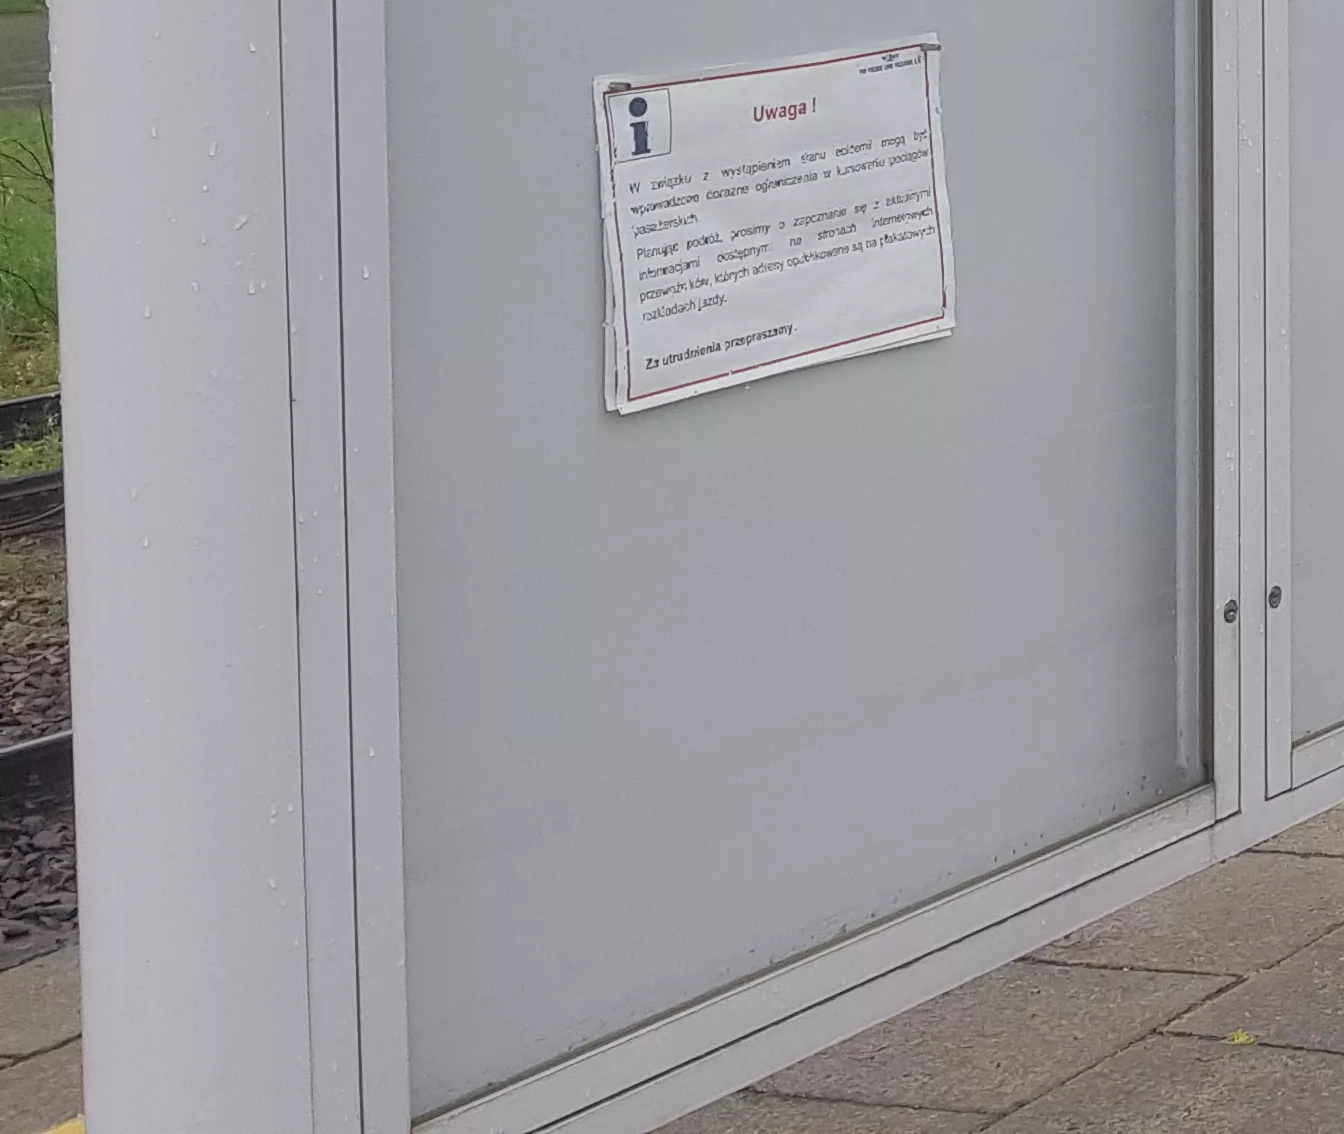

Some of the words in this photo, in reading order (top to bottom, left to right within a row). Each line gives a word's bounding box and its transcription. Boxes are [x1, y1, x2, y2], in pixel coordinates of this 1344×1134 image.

[753, 102, 807, 123] Uwaga
[629, 182, 641, 194] W
[702, 171, 710, 181] z
